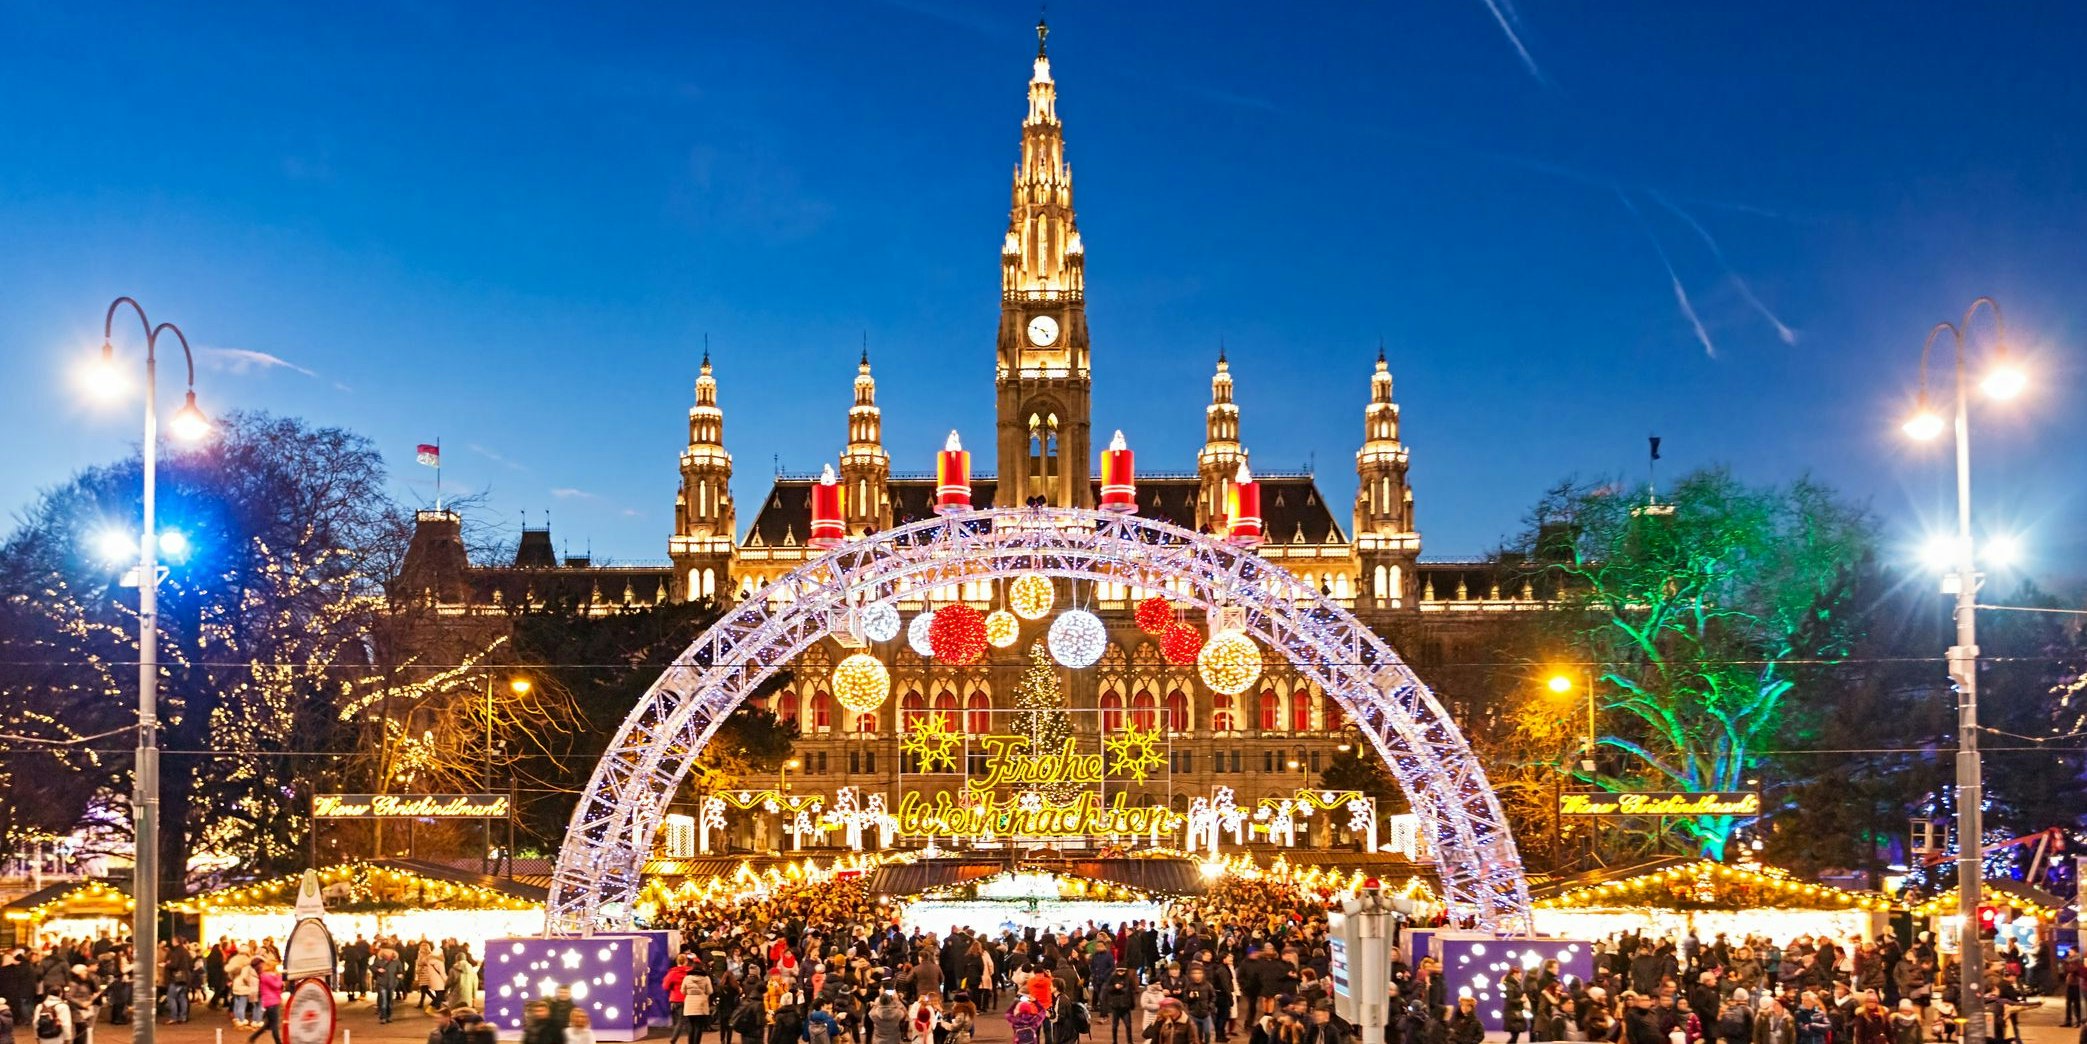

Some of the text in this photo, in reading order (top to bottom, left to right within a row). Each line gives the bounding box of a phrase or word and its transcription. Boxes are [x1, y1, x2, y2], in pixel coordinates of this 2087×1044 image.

[968, 735, 1104, 792] Frohe
[313, 795, 510, 816] Wiener Christkindlmarkt
[899, 790, 1171, 836] Weihnachten
[1560, 794, 1760, 814] Wiener Christkindlmarkt
